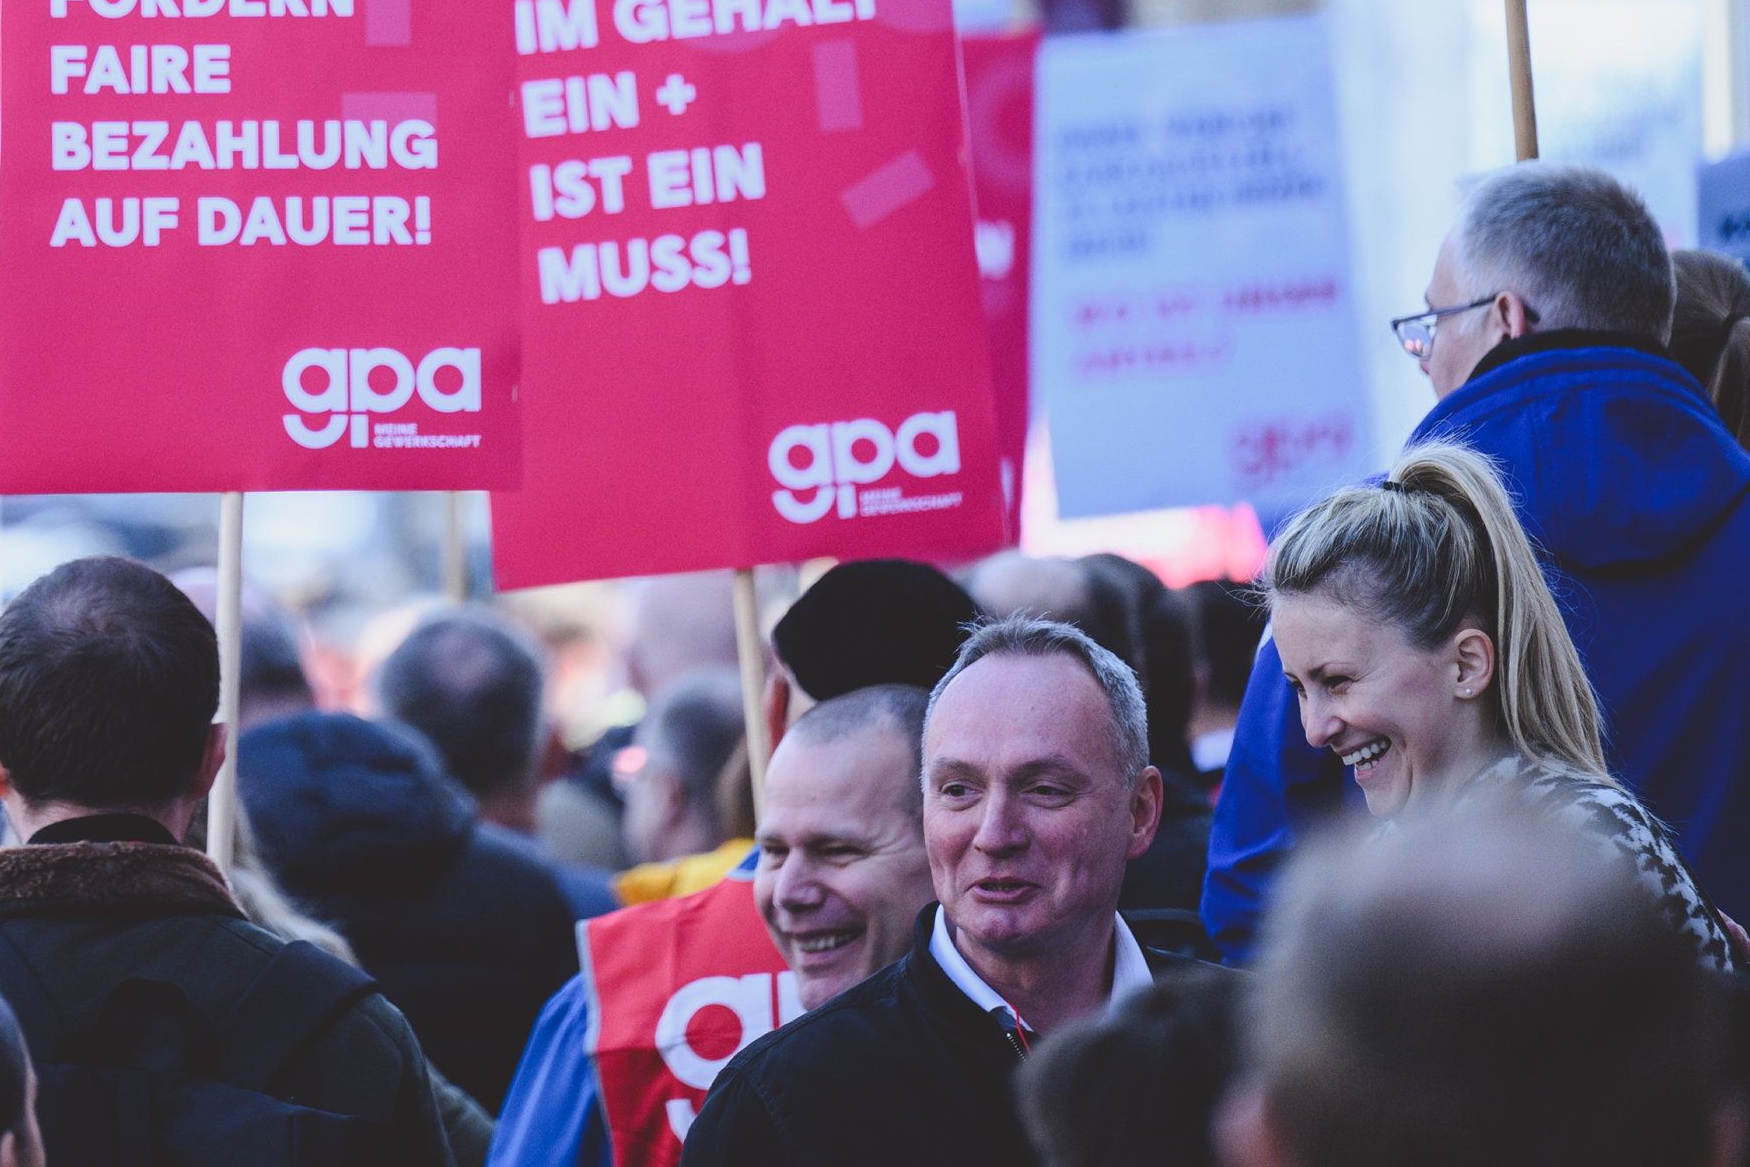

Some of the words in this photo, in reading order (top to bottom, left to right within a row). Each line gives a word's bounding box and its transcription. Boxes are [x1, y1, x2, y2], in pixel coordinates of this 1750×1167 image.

[50, 44, 232, 95] FAIRE
[520, 70, 639, 138] EIN
[51, 119, 439, 171] BEZAHLUNG
[529, 155, 633, 222] IST
[647, 142, 766, 210] EIN
[49, 197, 180, 248] AUF
[197, 196, 432, 247] DAUER!
[537, 228, 752, 305] MUSS!
[281, 347, 482, 449] gpa
[767, 409, 962, 524] gpa
